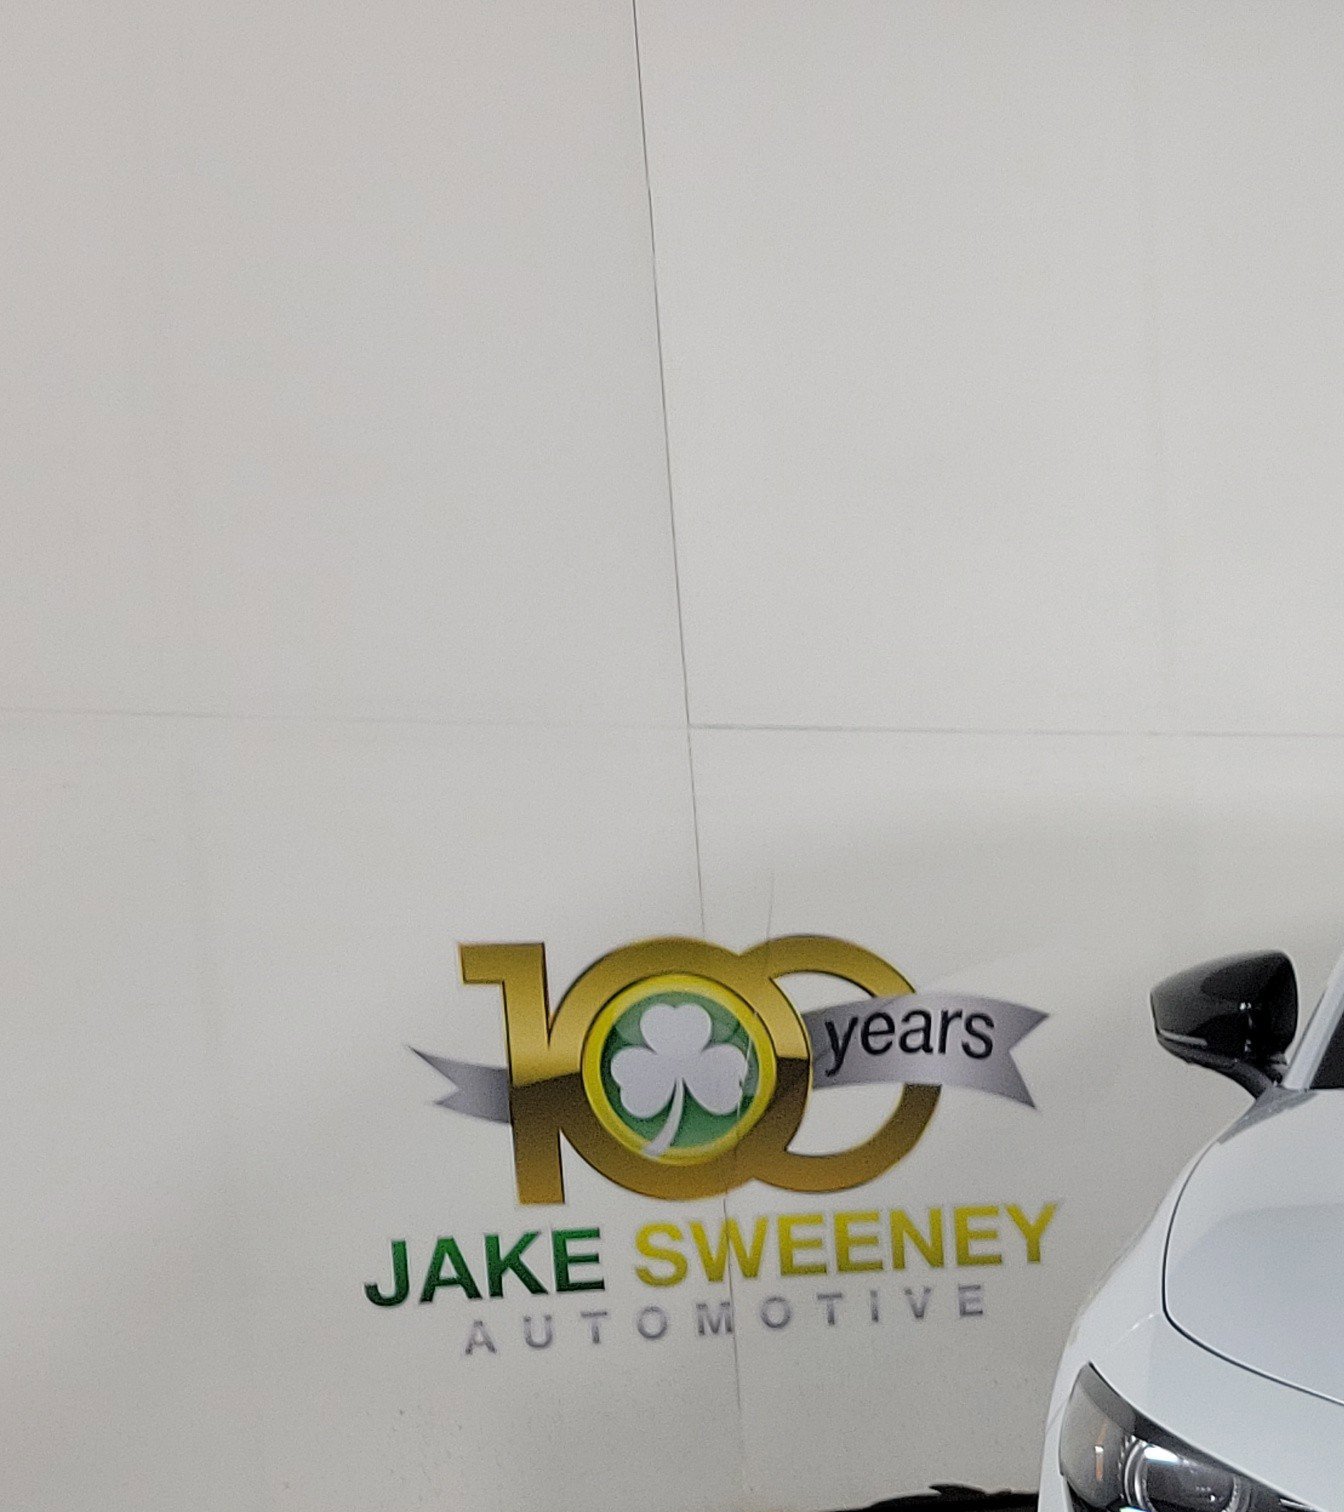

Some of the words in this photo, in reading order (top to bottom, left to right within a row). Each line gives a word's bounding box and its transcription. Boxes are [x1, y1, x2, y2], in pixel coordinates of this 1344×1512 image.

[458, 934, 941, 1205] 100
[824, 1008, 995, 1078] years
[364, 1227, 604, 1307] JAKE
[635, 1203, 1058, 1287] SWEENEY
[465, 1285, 984, 1356] AUTOMOTIVE
